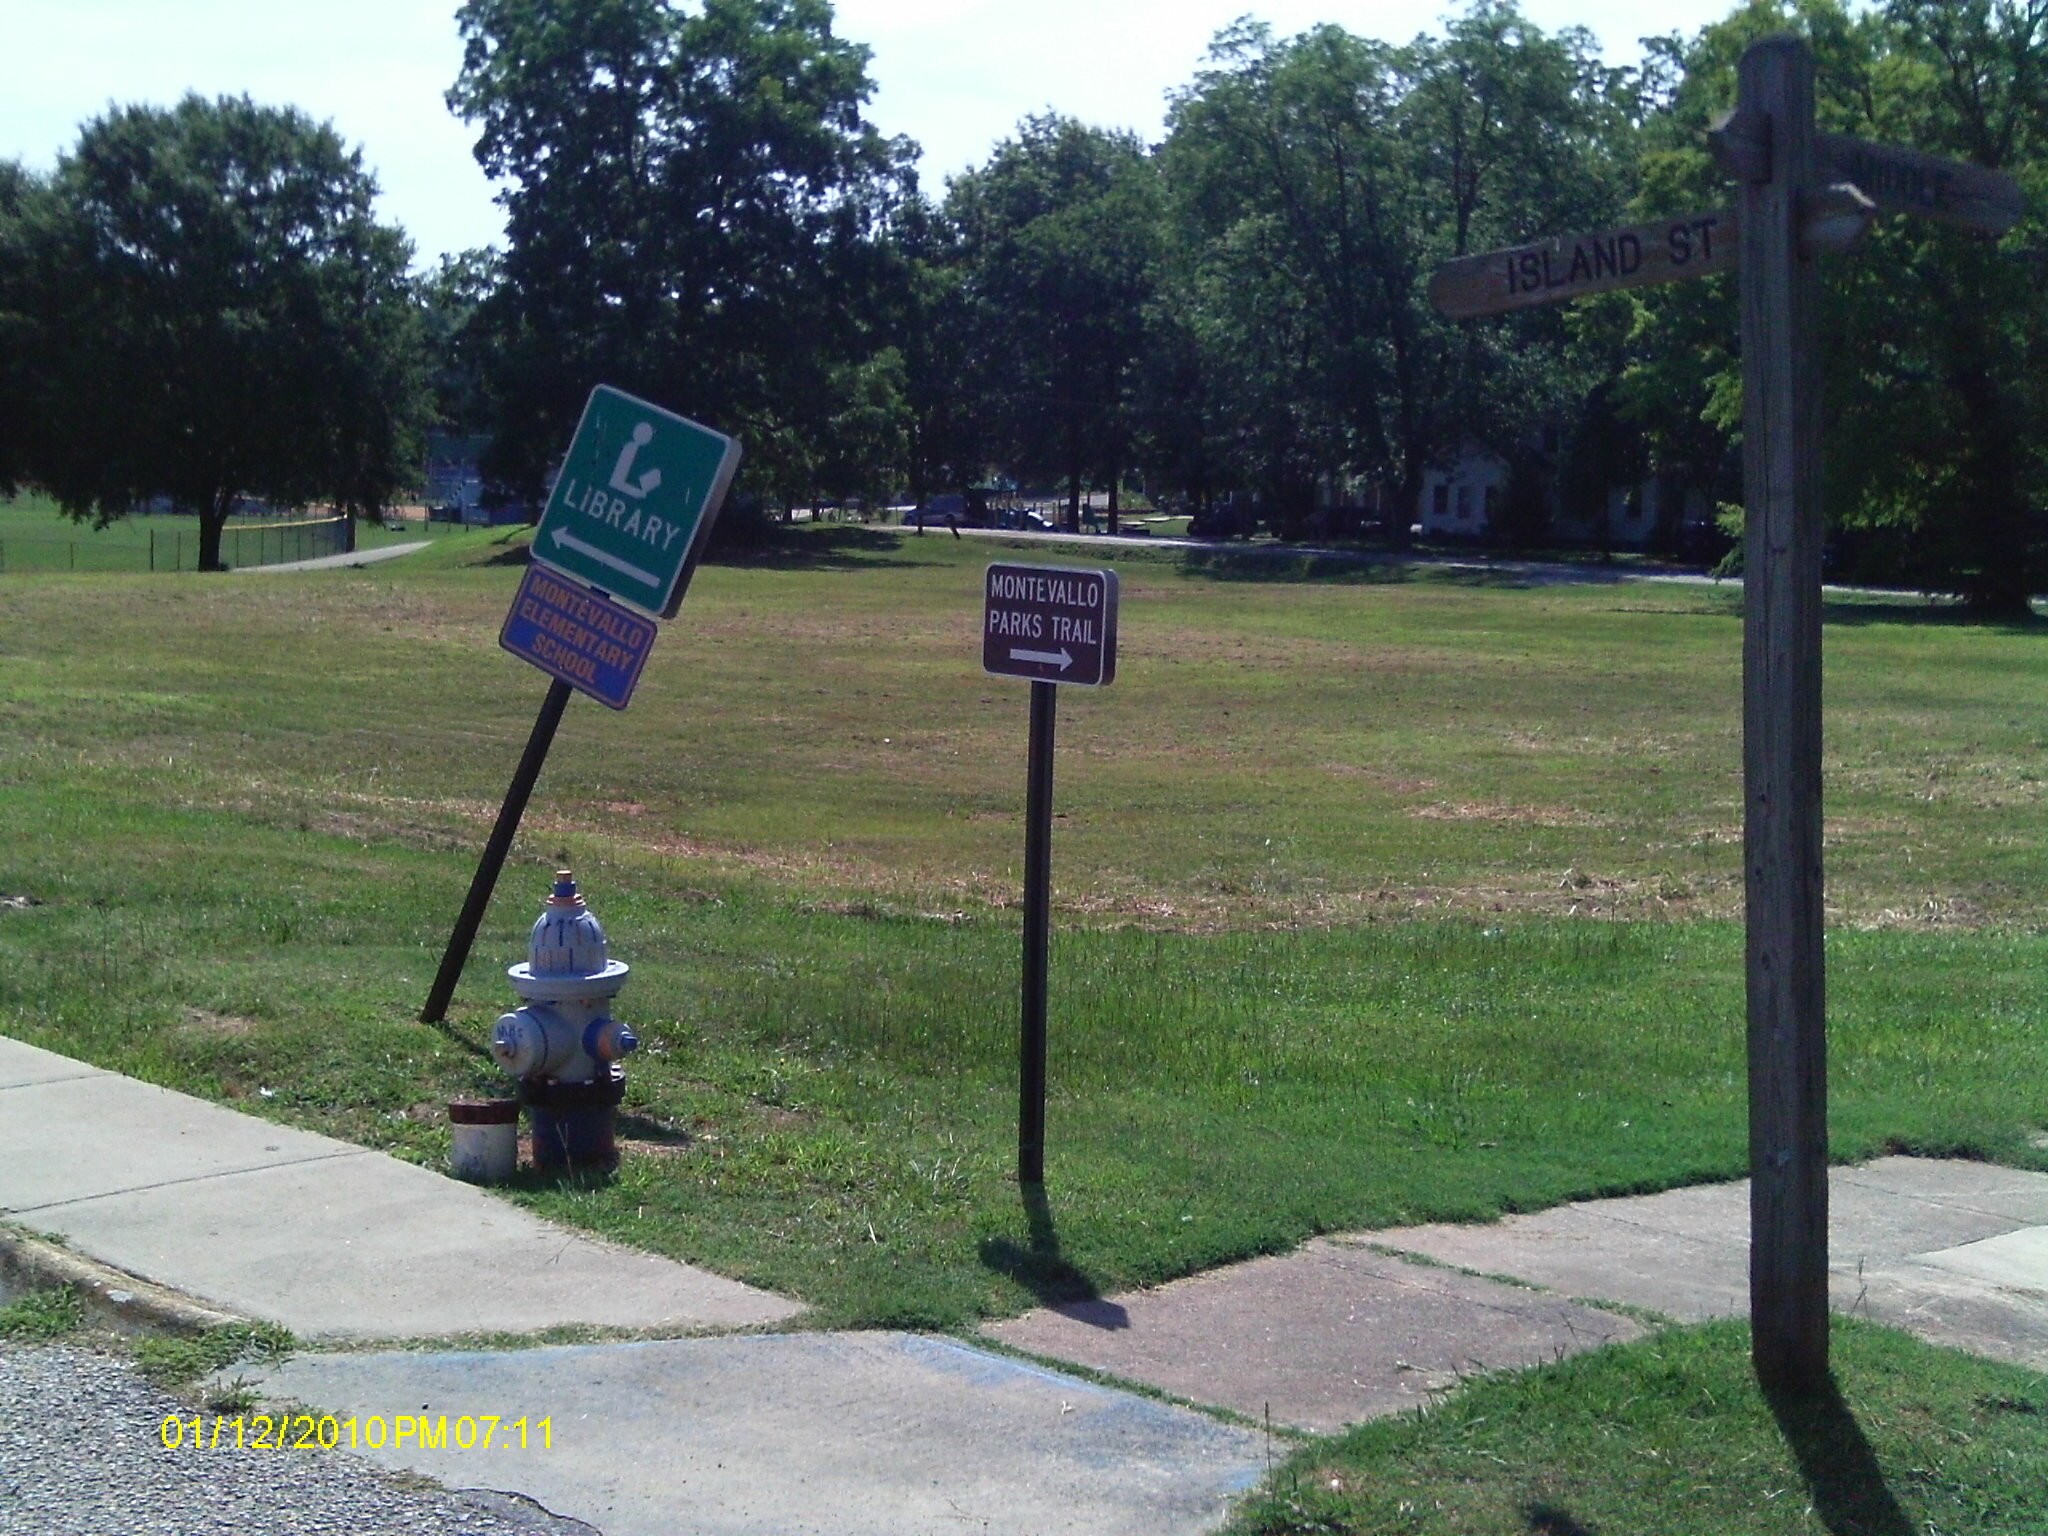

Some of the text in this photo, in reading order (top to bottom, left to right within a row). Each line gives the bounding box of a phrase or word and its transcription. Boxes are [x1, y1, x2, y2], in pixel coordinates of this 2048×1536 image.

[1508, 218, 1717, 294] ISLAND ST
[563, 478, 680, 551] LIBRARY
[530, 575, 643, 649] MONTEVALLO
[989, 609, 1097, 645] PARKS TRAIL
[991, 574, 1099, 608] MONTEVALLO
[522, 598, 634, 671] ELEMENTARY
[532, 633, 597, 684] SCHOOL
